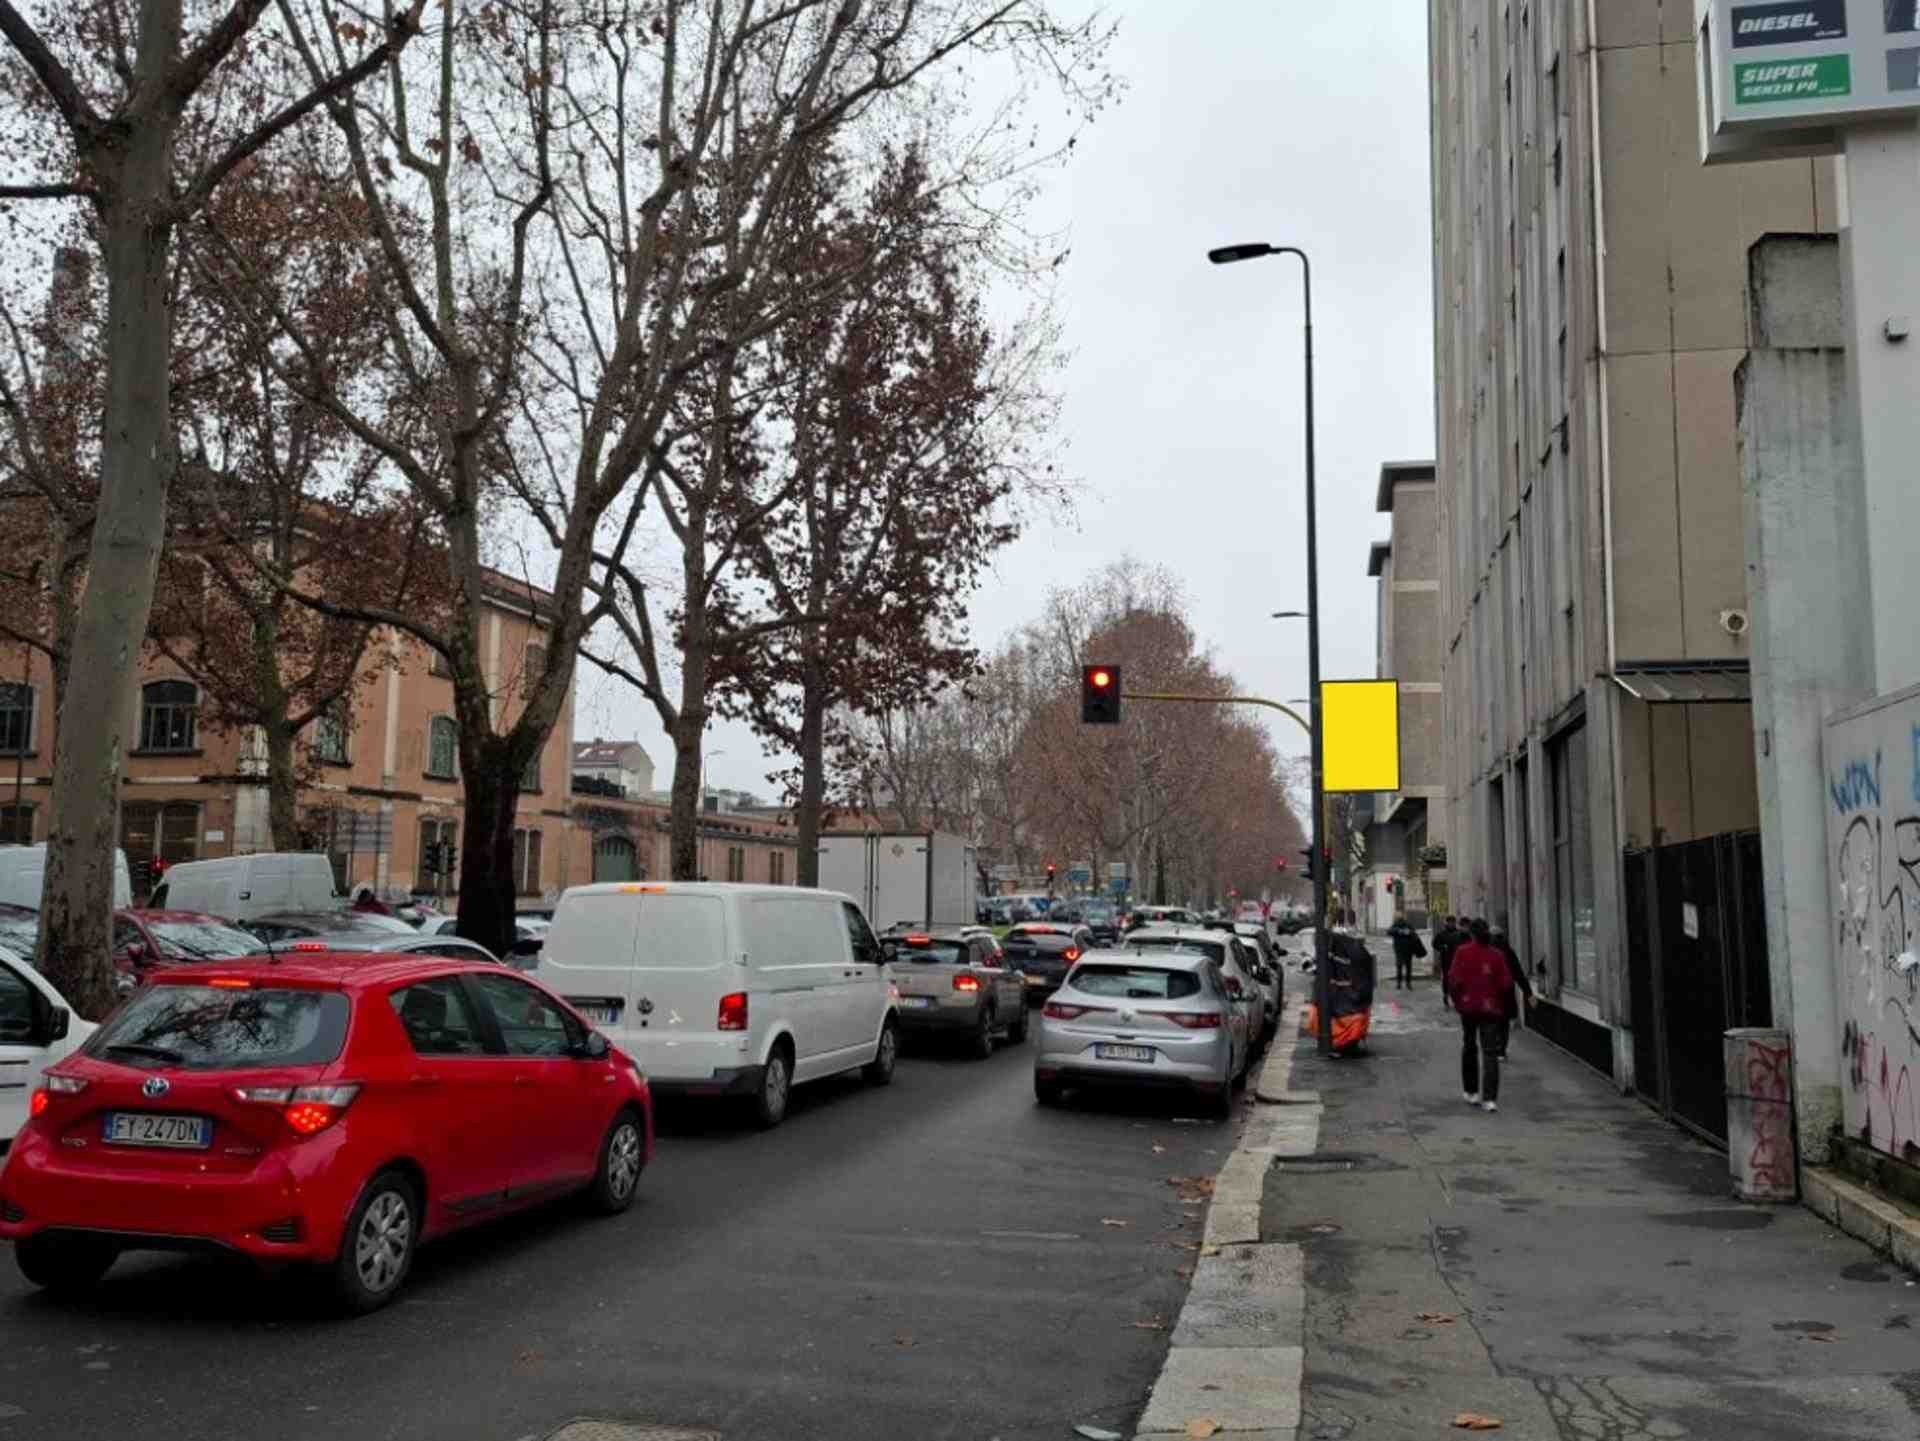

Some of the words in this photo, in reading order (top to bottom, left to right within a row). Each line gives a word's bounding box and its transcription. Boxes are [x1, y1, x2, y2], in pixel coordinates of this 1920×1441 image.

[1738, 12, 1819, 33] DIESEL
[1742, 63, 1818, 82] SUPER
[1743, 83, 1793, 97] SENZA
